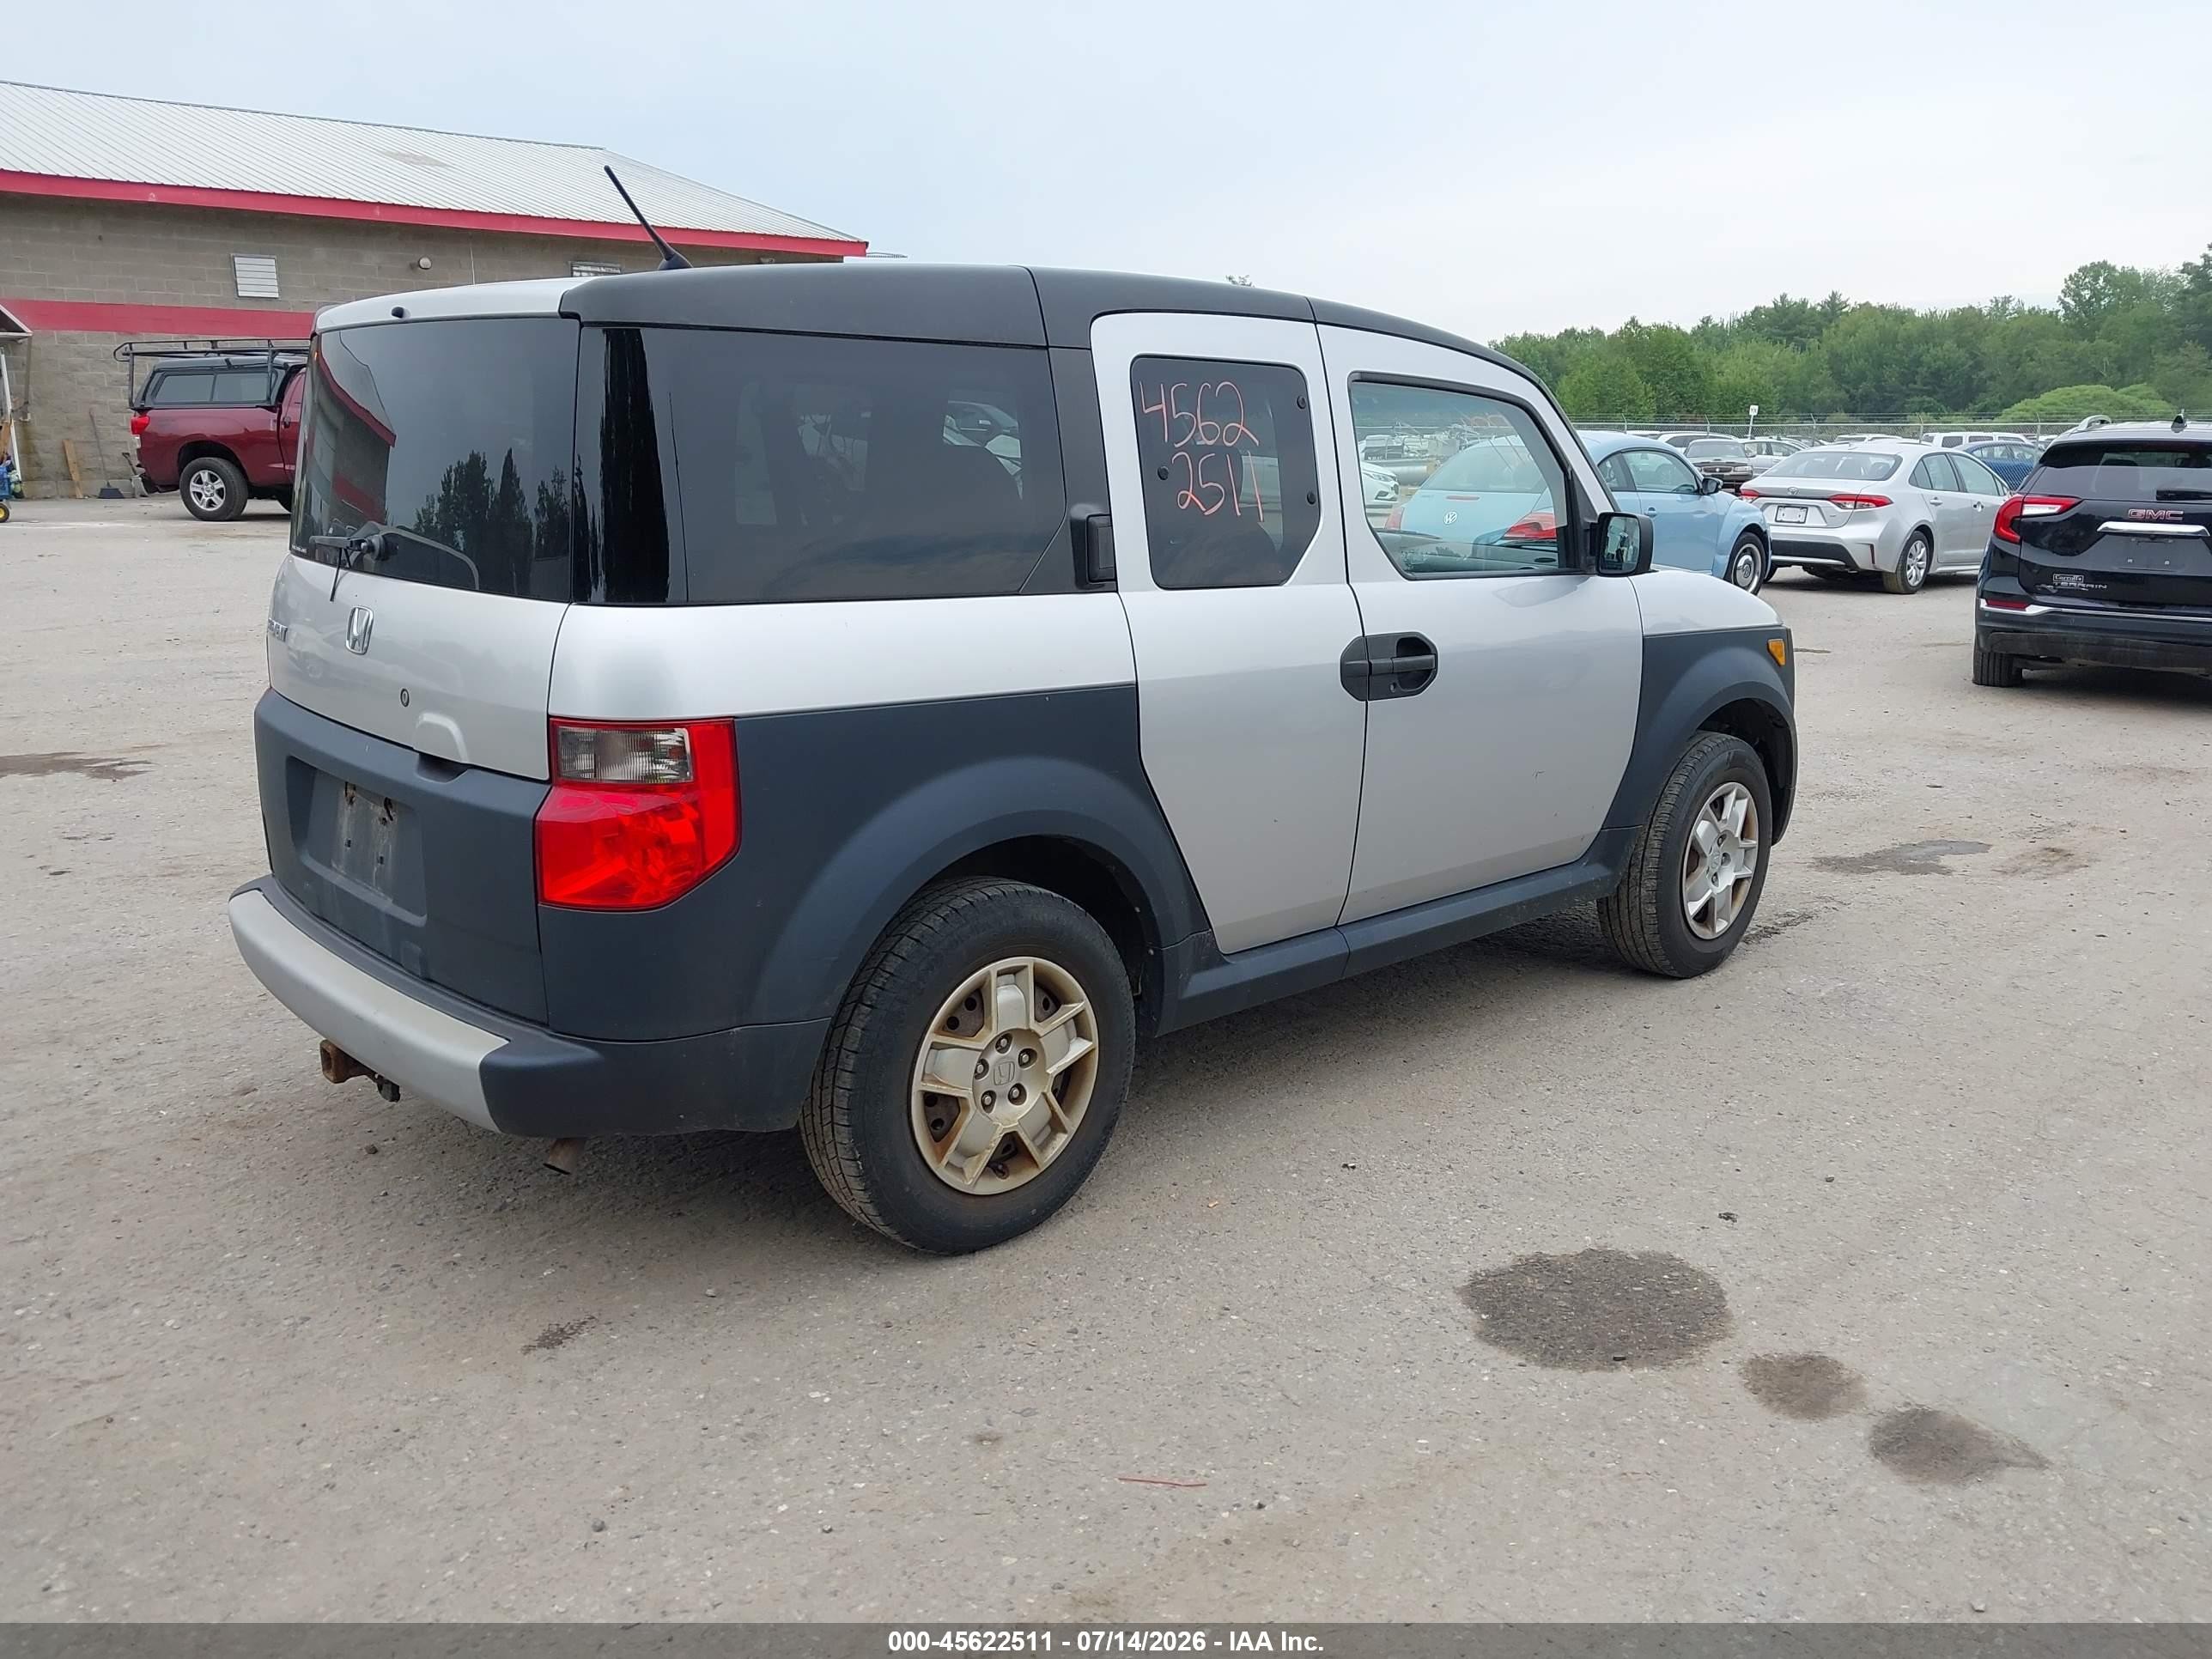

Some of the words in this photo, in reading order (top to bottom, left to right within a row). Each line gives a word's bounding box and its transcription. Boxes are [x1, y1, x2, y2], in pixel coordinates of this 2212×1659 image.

[1139, 380, 1260, 447] 4562
[1171, 451, 1265, 522] 2511
[2129, 508, 2184, 520] GMC
